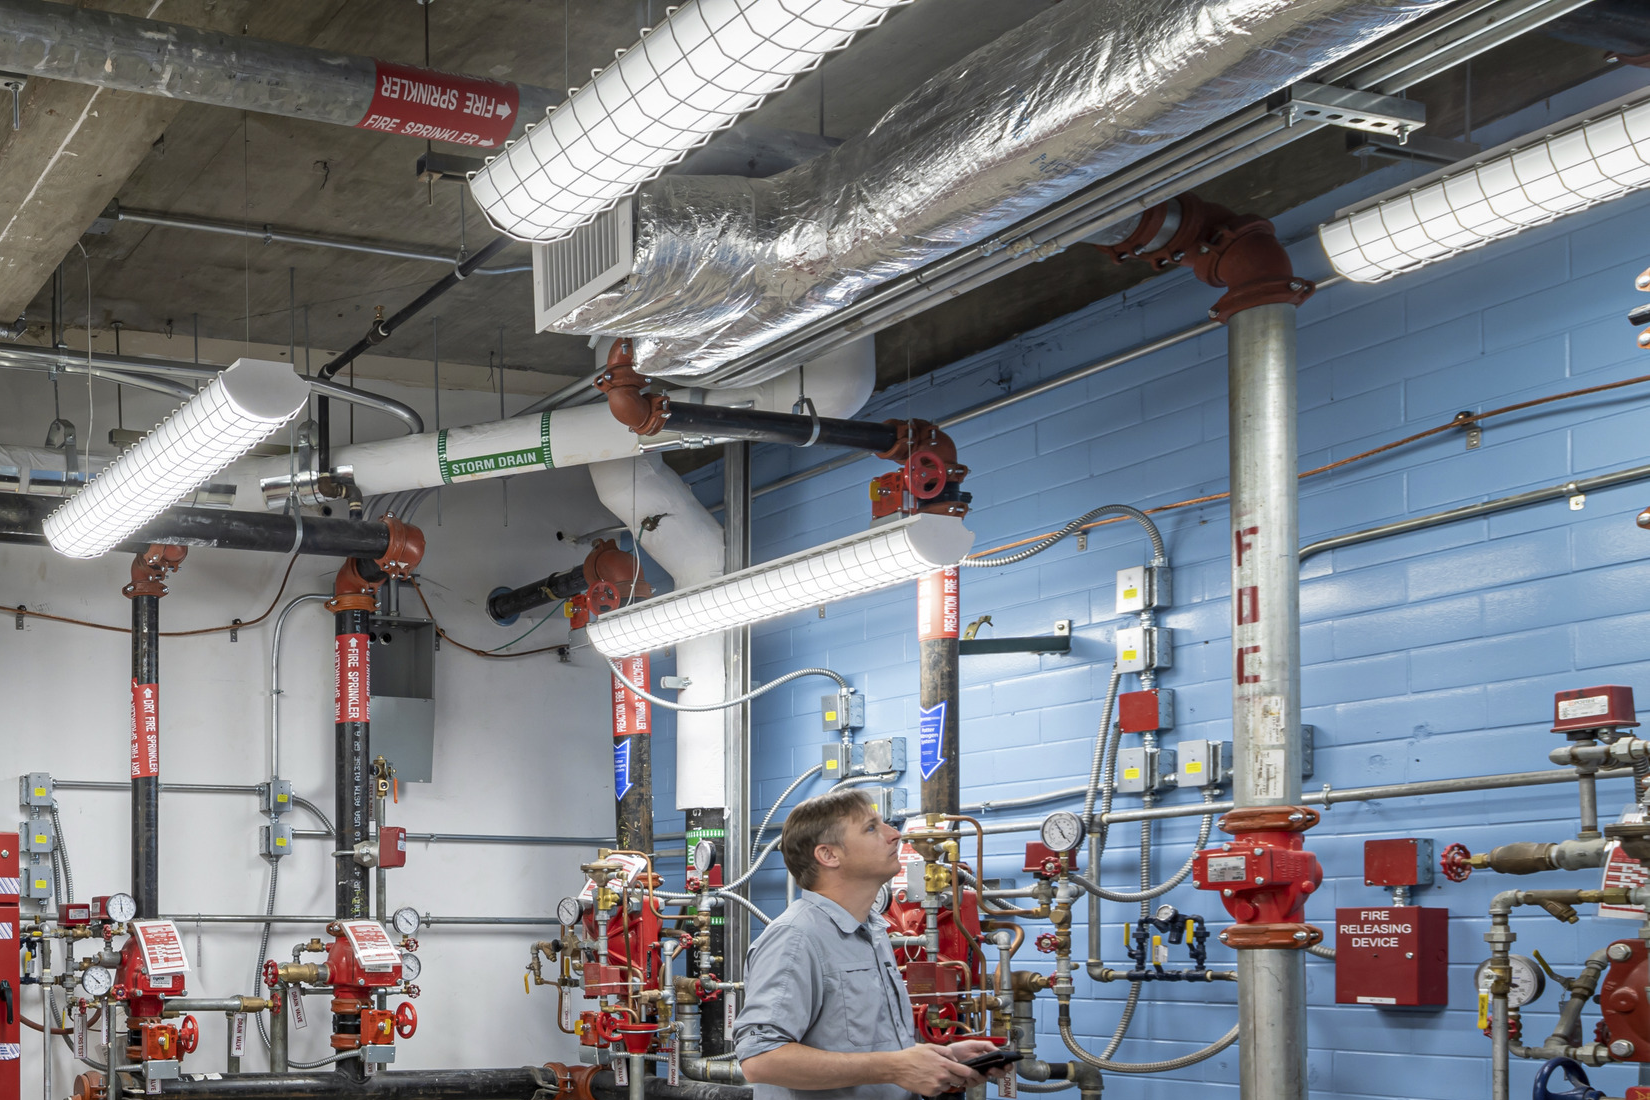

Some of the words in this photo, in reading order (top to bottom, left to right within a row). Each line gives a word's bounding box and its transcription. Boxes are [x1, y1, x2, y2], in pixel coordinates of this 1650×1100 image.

[382, 76, 458, 110] SPRINKLER
[464, 93, 495, 118] FIRE
[364, 115, 400, 131] FIRE
[401, 122, 479, 144] SPRINKLER
[452, 459, 495, 474] STORM
[499, 452, 536, 467] DRAIN
[348, 649, 359, 668] FIRE
[348, 672, 359, 718] SPRINKLER
[144, 700, 155, 713] DRY
[145, 717, 156, 732] FIRE
[147, 735, 158, 773] SPRINKLER
[1361, 911, 1389, 920] FIRE
[1340, 924, 1412, 934] RELEASING
[1352, 938, 1398, 947] DEVICE
